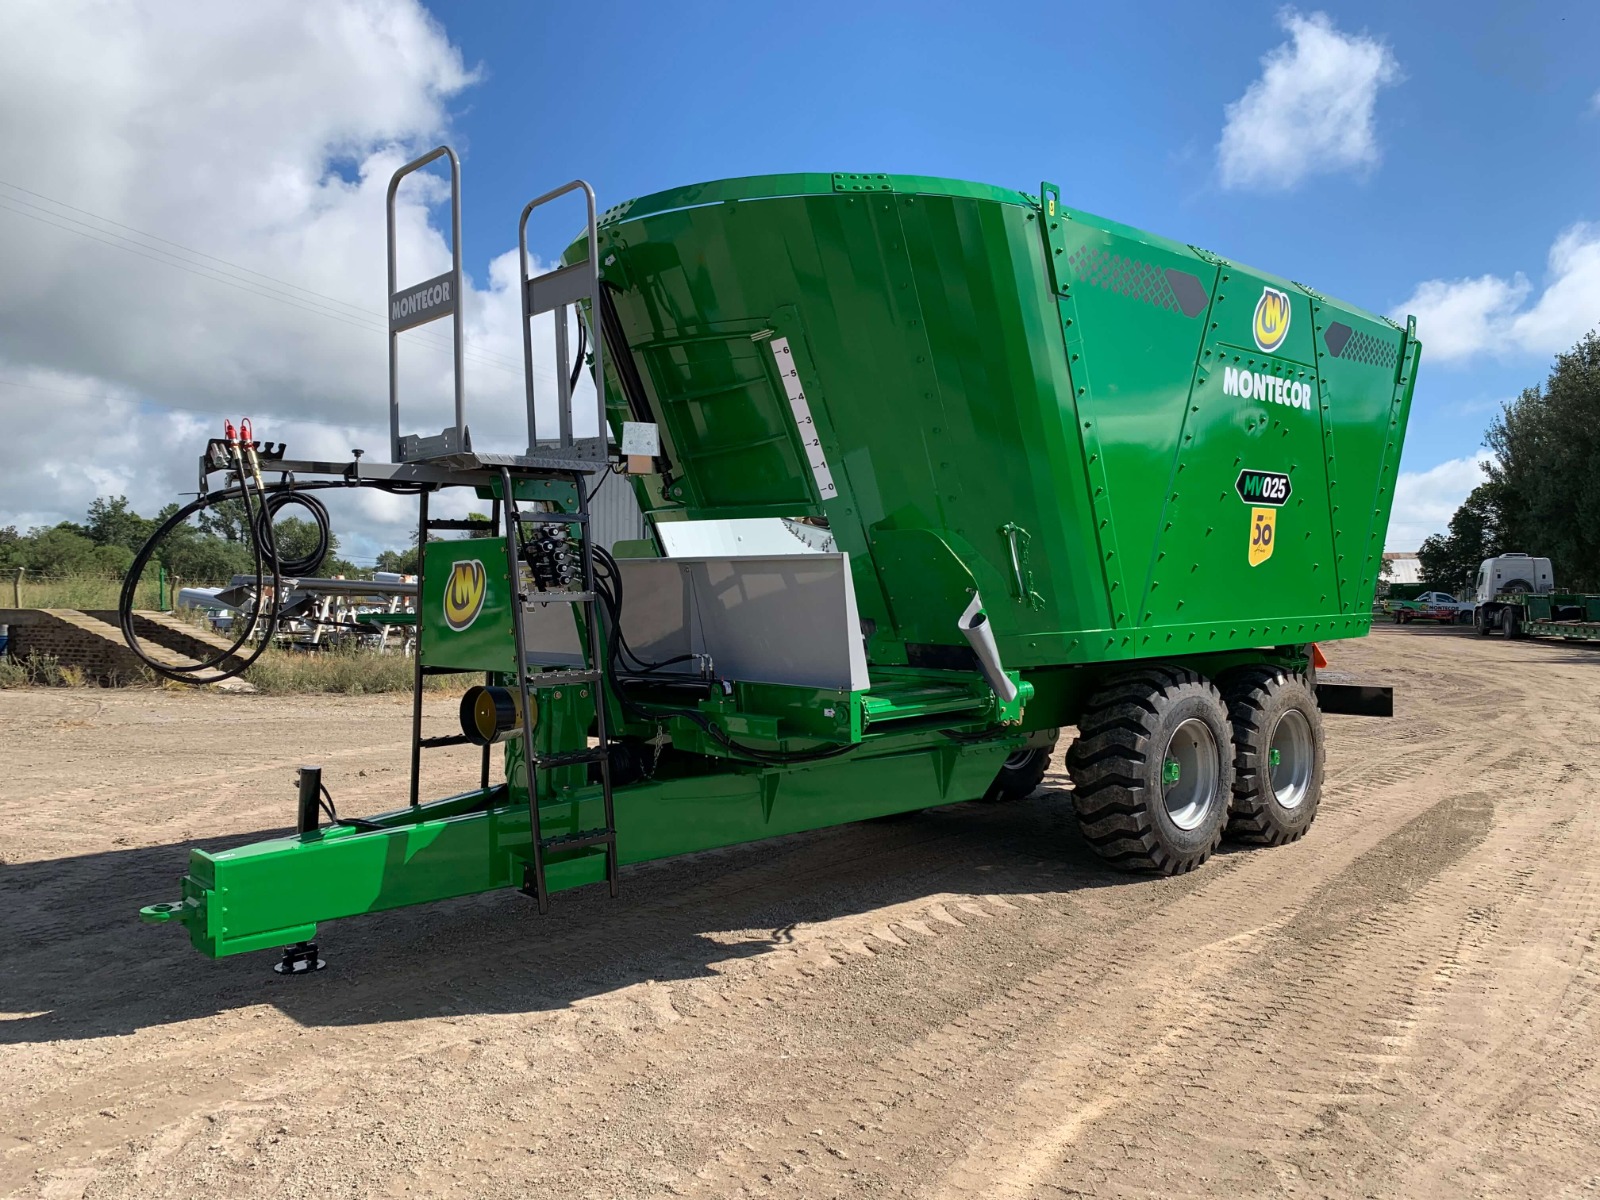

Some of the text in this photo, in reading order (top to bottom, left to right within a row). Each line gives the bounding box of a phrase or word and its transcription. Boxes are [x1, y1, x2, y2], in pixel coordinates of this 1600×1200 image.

[392, 281, 450, 320] MONTECOR
[783, 346, 790, 354] 6
[790, 369, 797, 377] 5
[1223, 366, 1311, 410] MONTECOR
[798, 392, 805, 400] 4
[805, 416, 812, 424] 3
[813, 438, 819, 446] 2
[820, 461, 827, 469] 1
[828, 483, 834, 491] 0
[1243, 474, 1287, 498] MV025
